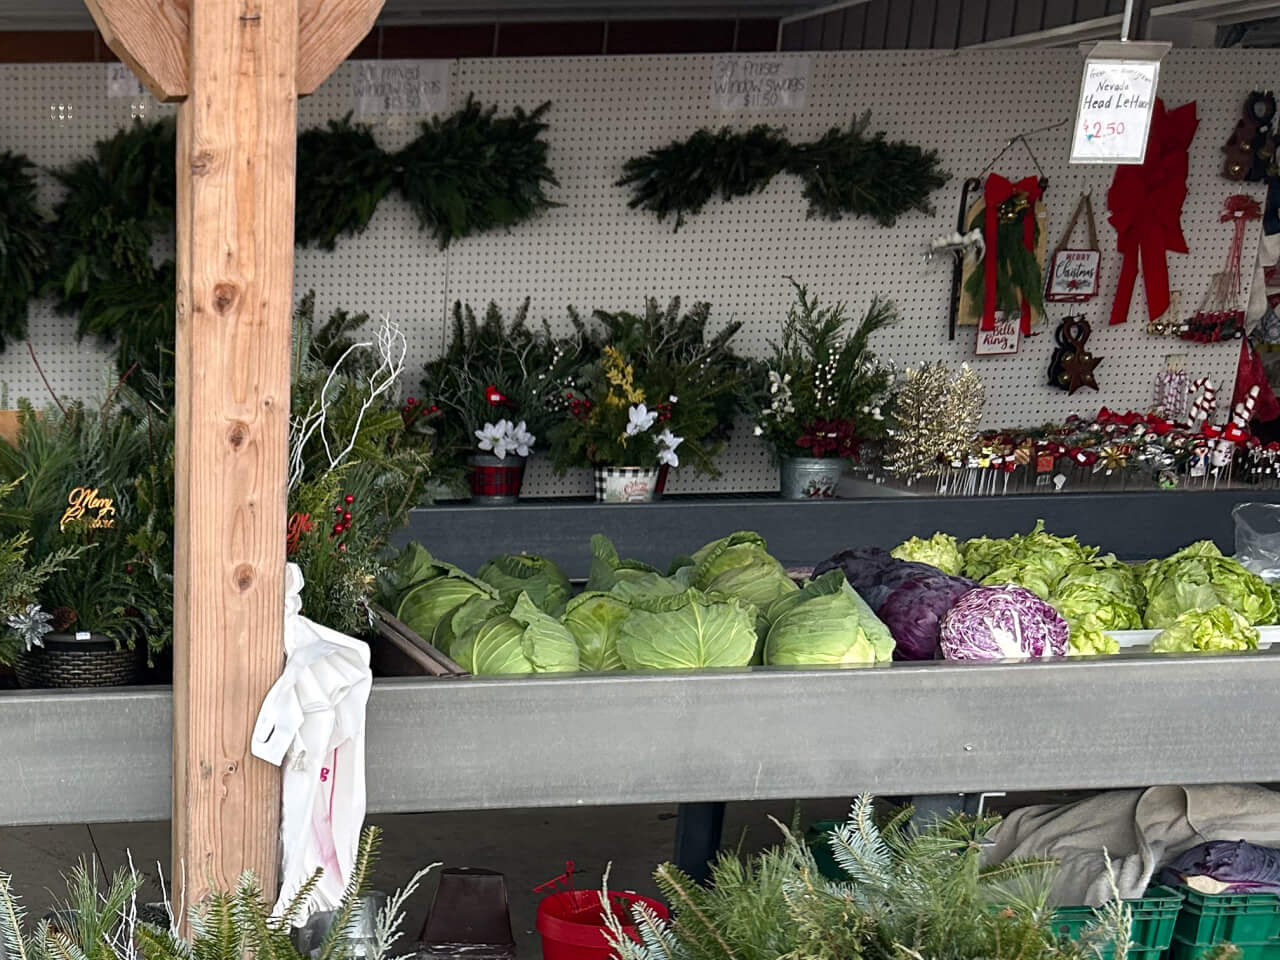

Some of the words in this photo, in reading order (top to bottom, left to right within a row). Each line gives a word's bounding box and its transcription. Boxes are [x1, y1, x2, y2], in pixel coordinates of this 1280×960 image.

[1096, 79, 1129, 92] Nevada
[1083, 93, 1113, 109] Head
[1056, 259, 1095, 279] Christmas
[983, 334, 1008, 351] Ring
[67, 487, 116, 516] Merry
